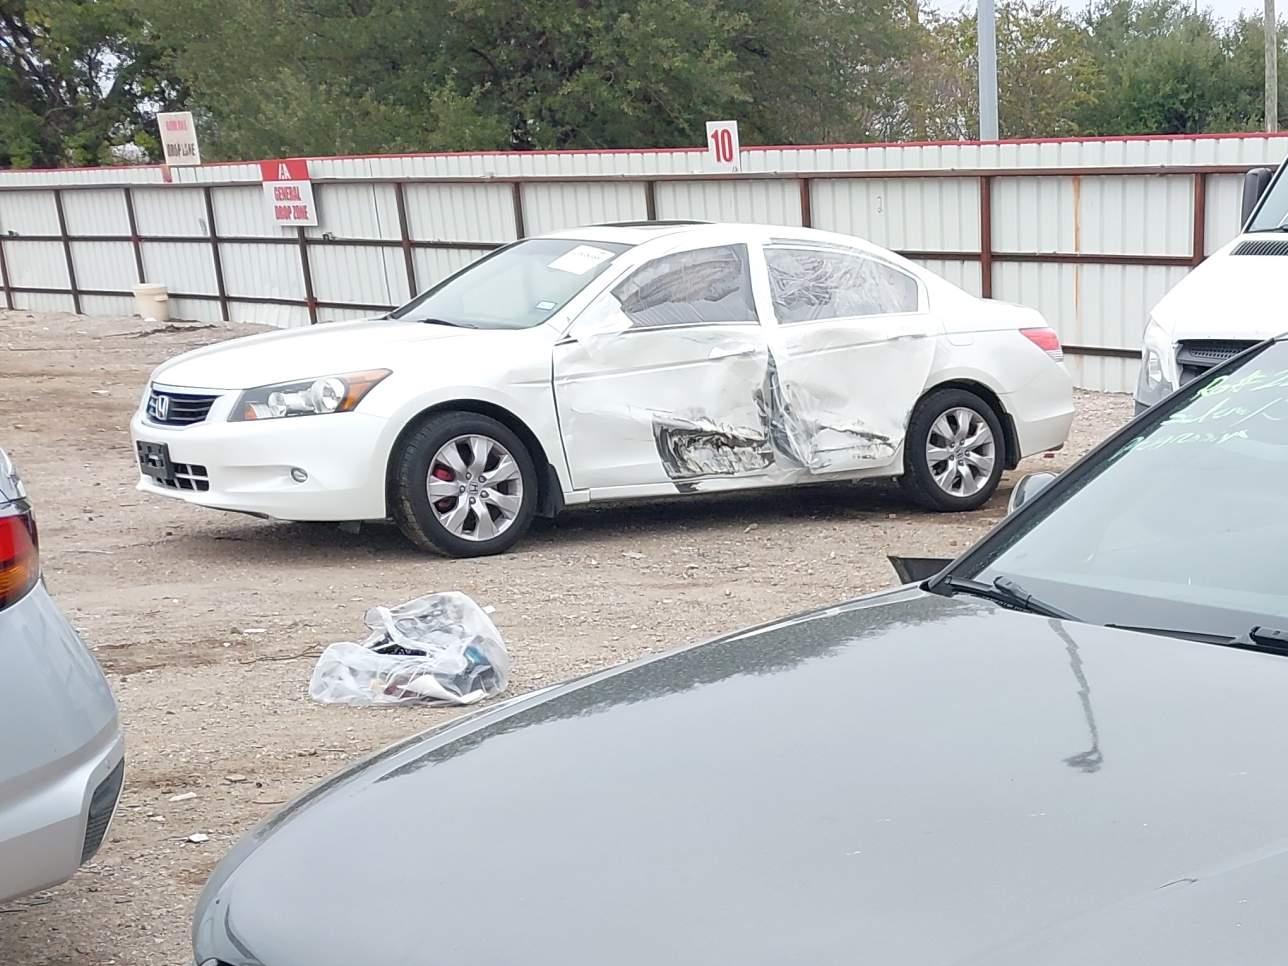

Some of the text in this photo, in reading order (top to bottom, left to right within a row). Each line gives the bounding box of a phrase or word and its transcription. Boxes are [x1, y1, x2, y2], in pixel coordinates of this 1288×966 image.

[711, 129, 733, 162] 10
[274, 186, 301, 201] GENERAL
[274, 205, 309, 220] DROP ZONE
